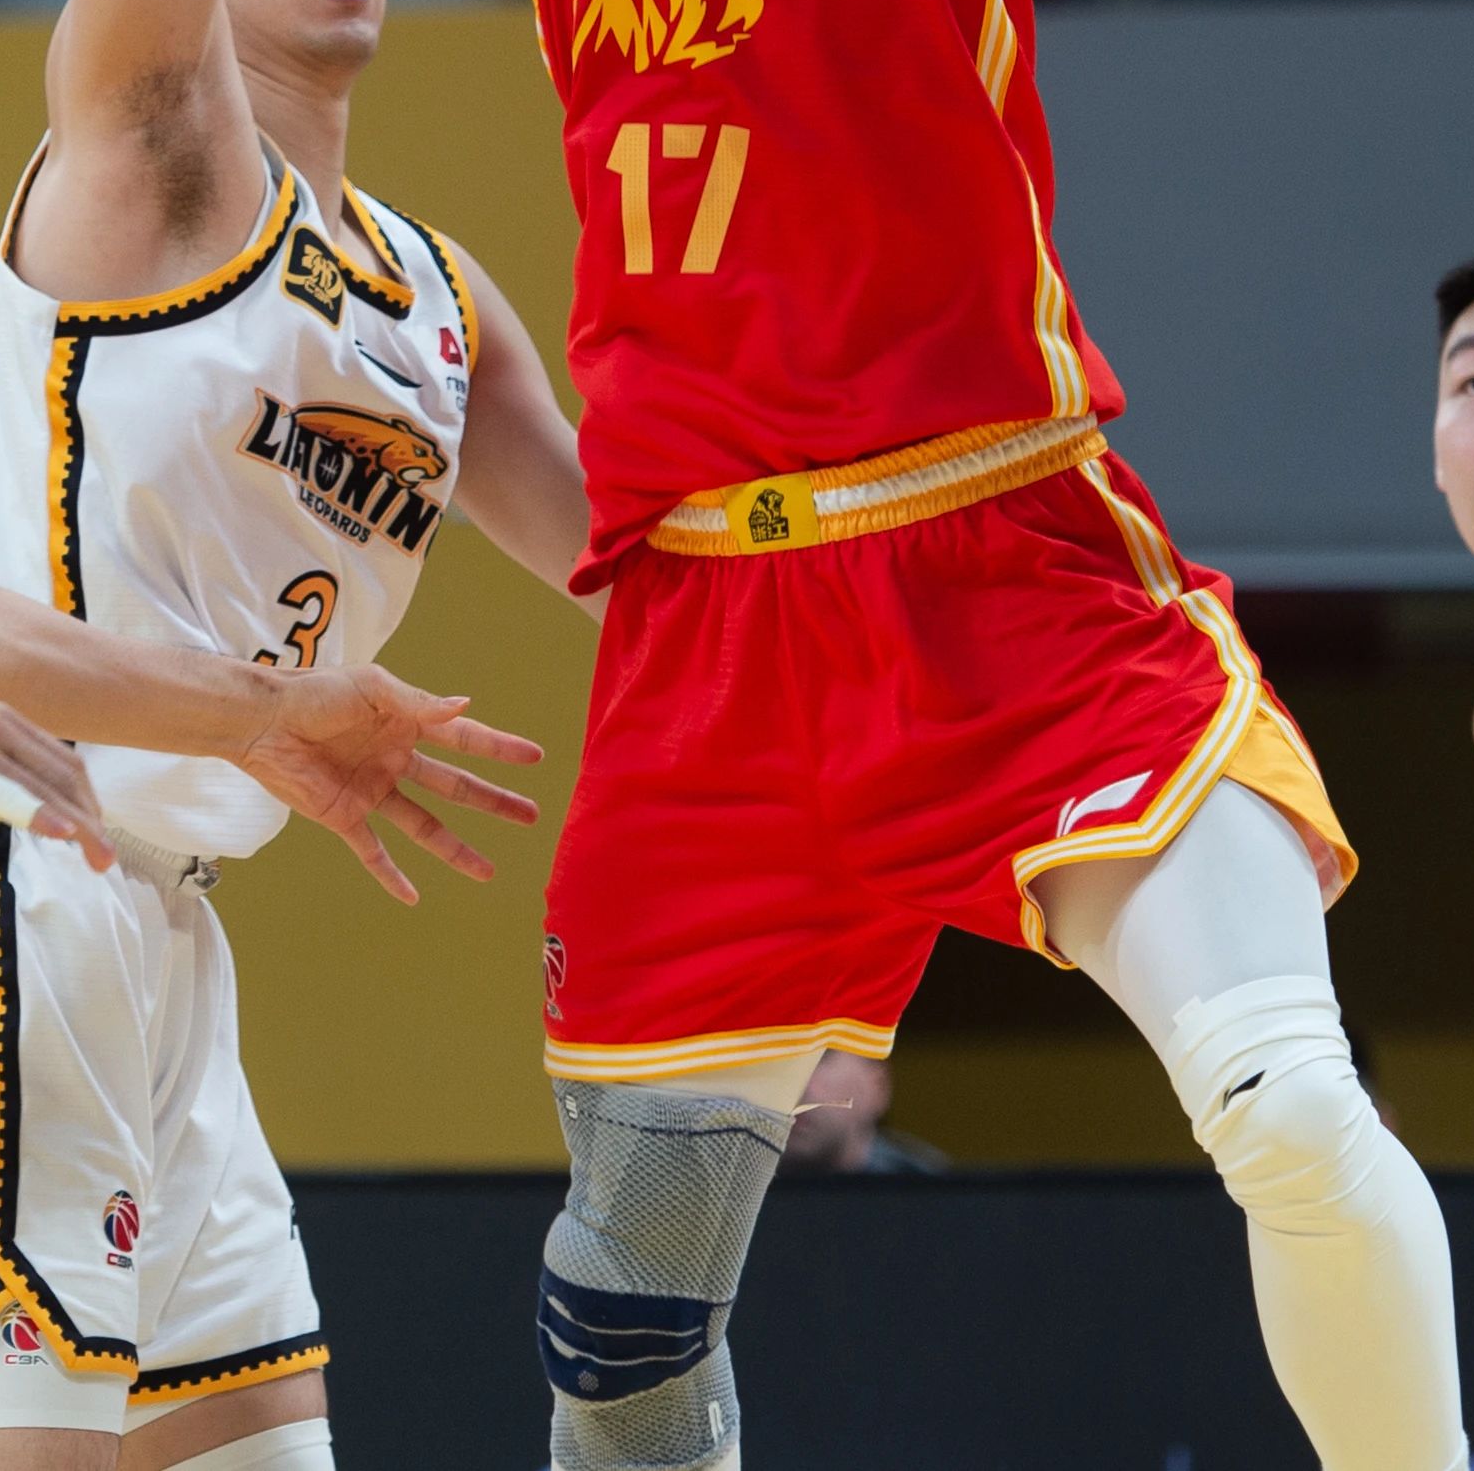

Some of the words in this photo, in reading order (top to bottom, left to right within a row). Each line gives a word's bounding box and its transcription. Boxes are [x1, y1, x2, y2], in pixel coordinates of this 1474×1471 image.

[605, 122, 751, 275] 17
[245, 396, 444, 559] LIAONIN
[299, 484, 372, 545] LEOPARDS
[252, 570, 339, 669] 3
[106, 1252, 135, 1273] CBA
[4, 1353, 49, 1366] CBA
